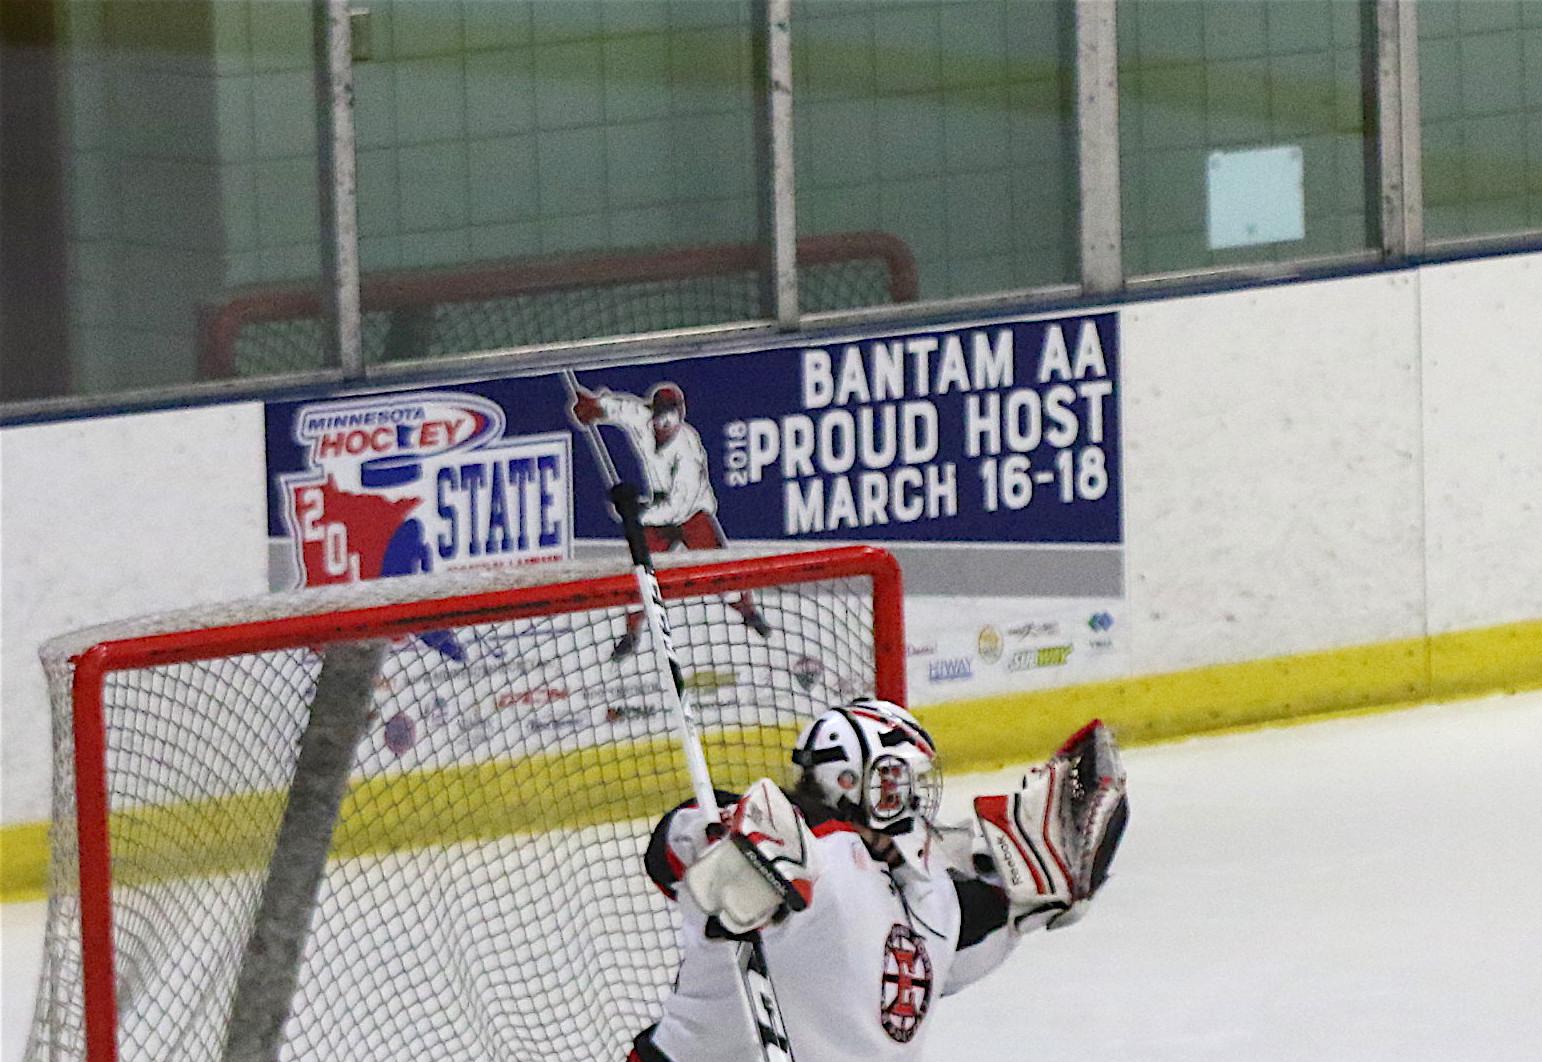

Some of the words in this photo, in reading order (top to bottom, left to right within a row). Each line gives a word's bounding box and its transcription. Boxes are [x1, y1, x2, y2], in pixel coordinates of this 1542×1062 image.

[804, 330, 1013, 408] BANTAM
[1038, 320, 1107, 383] AA
[307, 406, 425, 430] MINNESOTA
[748, 401, 938, 483] PROUD
[966, 381, 1112, 457] HOST
[436, 455, 562, 559] STATE
[785, 461, 957, 535] MARCH
[980, 445, 1108, 511] 16-18
